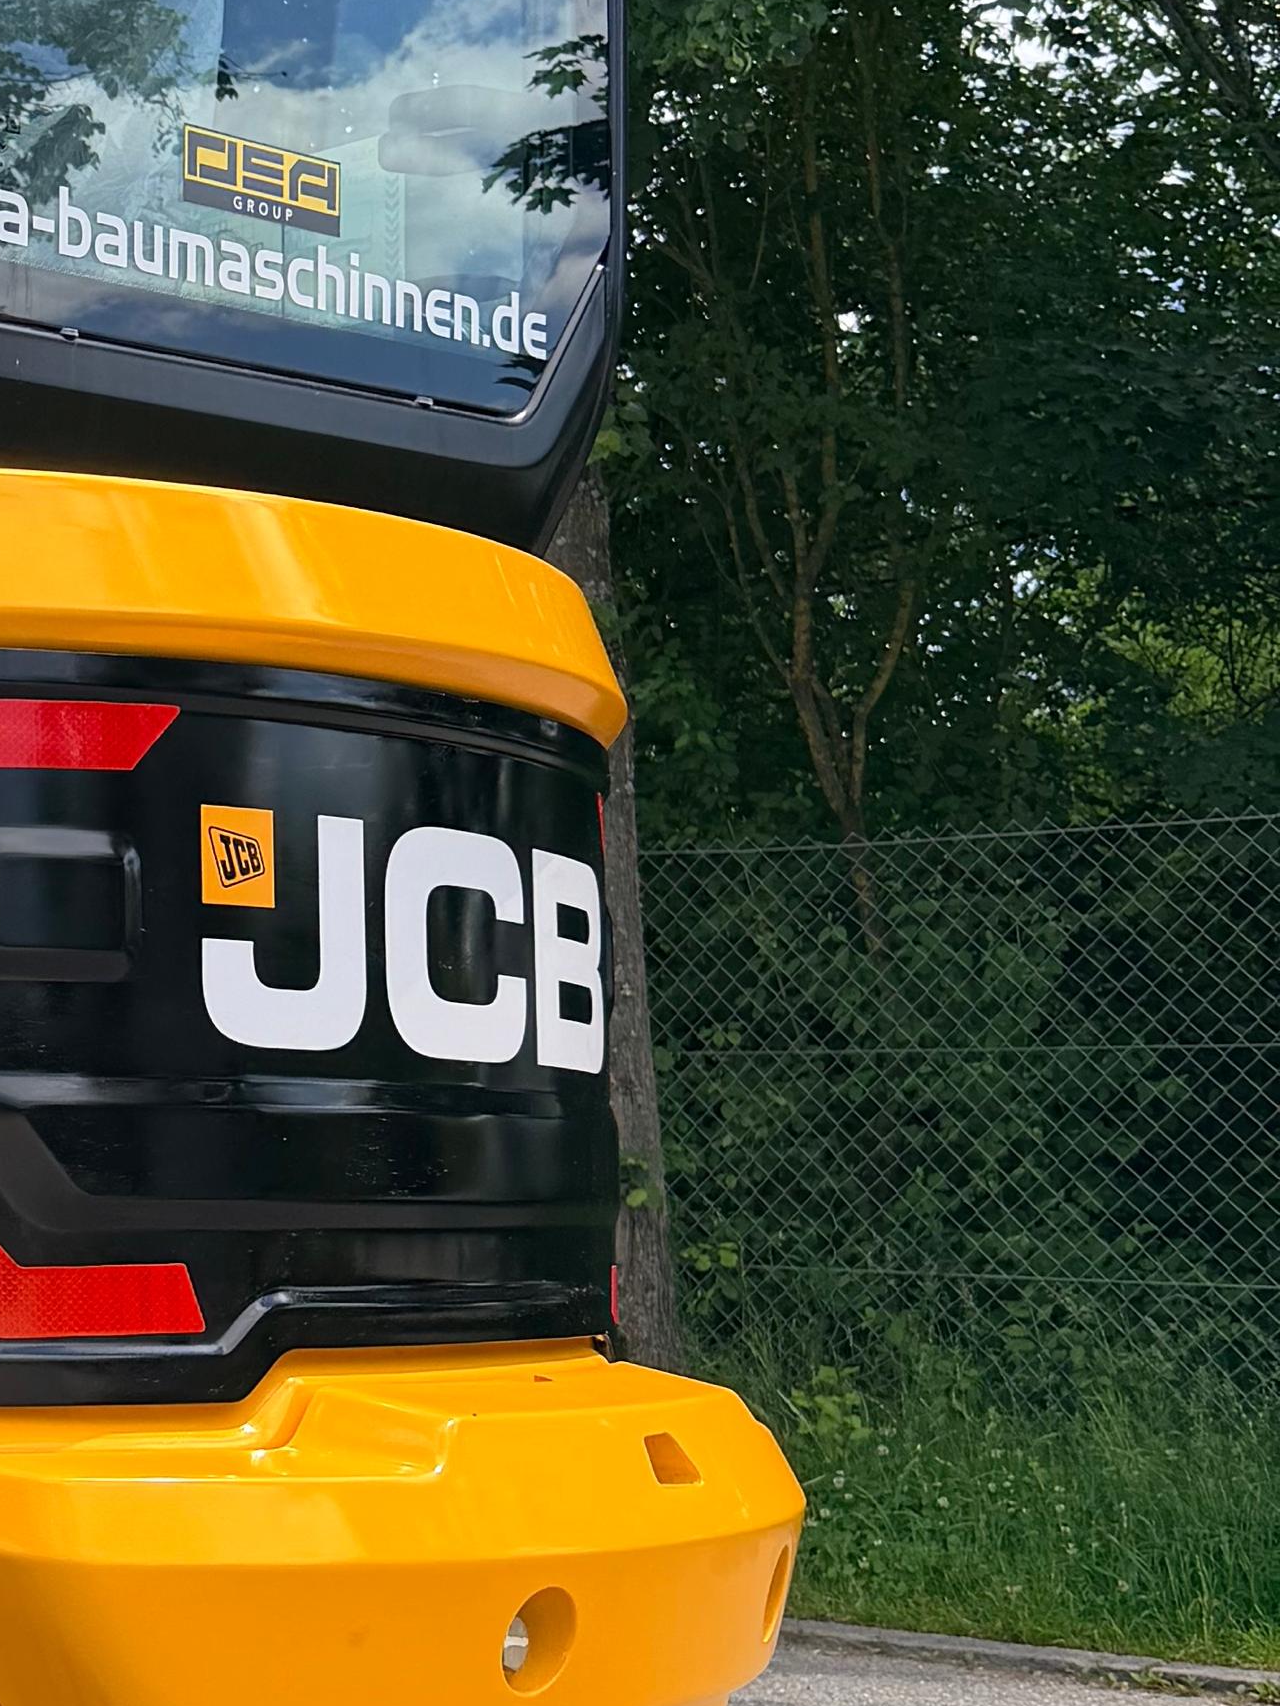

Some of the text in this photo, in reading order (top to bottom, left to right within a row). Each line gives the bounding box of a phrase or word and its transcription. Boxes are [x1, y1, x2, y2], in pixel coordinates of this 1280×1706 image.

[233, 195, 293, 222] GROUP
[215, 834, 262, 881] JCB
[201, 814, 605, 1075] JCB
